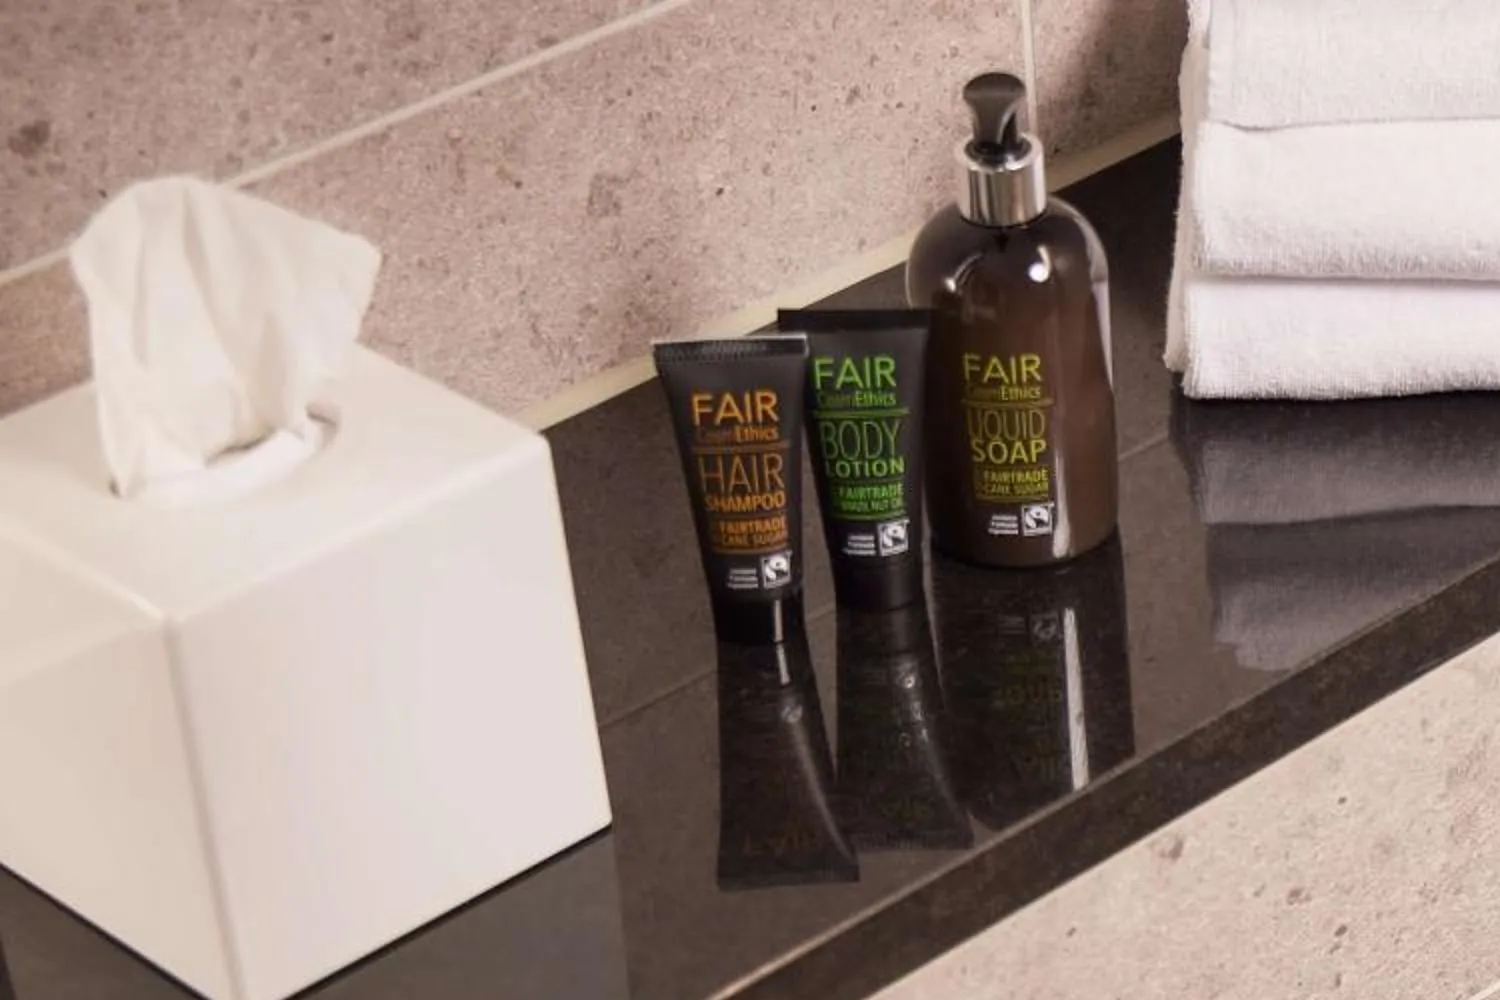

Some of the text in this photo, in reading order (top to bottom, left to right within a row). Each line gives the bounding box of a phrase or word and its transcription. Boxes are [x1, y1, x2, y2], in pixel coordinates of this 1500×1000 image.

[814, 356, 897, 389] FAIR
[962, 352, 1042, 384] FAIR
[691, 389, 780, 426] FAIR
[820, 419, 901, 461] BODY
[966, 408, 1046, 441] LIQUID
[971, 438, 1048, 464] SOAP
[700, 452, 785, 493] HAIR
[825, 457, 905, 479] LOTION
[704, 490, 787, 512] SHAMPOO
